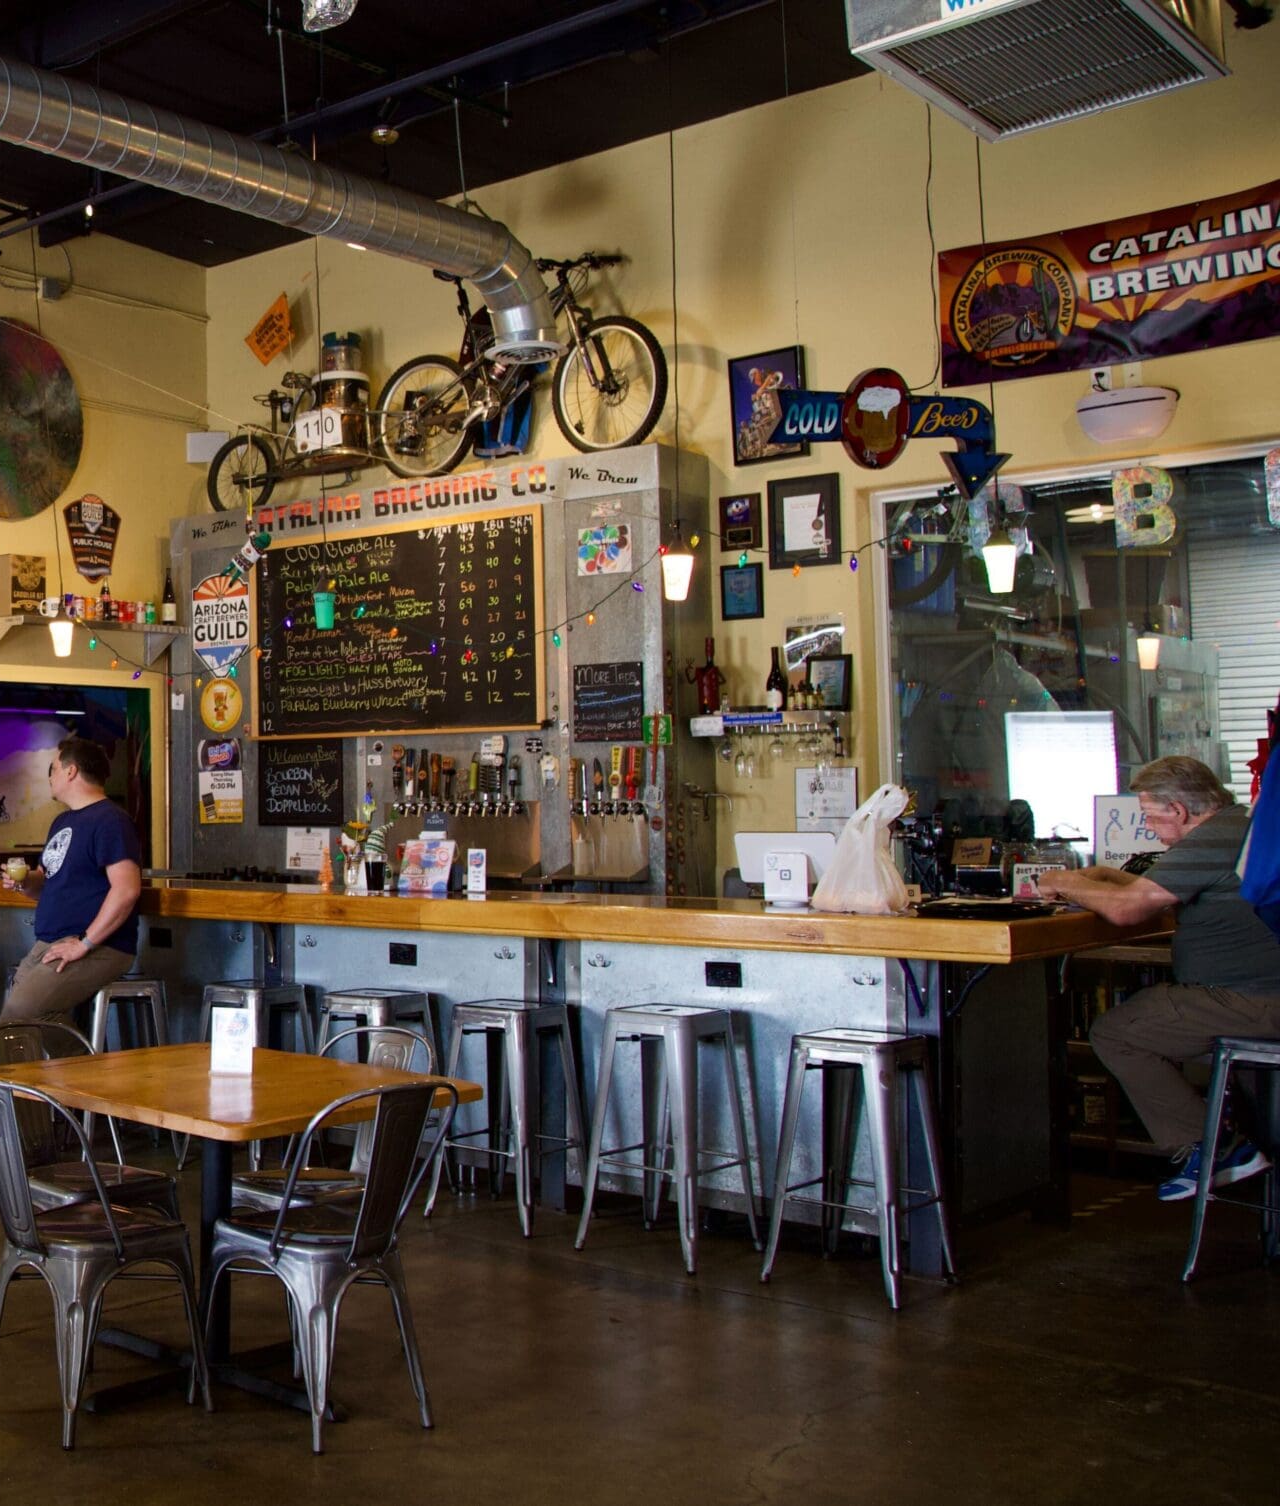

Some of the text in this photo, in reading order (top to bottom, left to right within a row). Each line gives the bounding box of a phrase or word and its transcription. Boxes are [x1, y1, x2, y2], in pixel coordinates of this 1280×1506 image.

[1087, 203, 1280, 264] CATALIN
[956, 269, 983, 332] CATALINA
[1046, 261, 1072, 328] COMPANY
[302, 416, 335, 439] 110
[785, 402, 978, 435] COLD Beer
[568, 467, 639, 485] We Brew
[373, 472, 498, 517] BREWING
[510, 464, 556, 497] CO.
[510, 515, 533, 529] SRM
[73, 538, 93, 546] PUBLIC
[285, 543, 321, 564] CDO
[339, 575, 367, 588] Pale
[370, 571, 391, 584] Ale
[438, 562, 446, 575] 7
[438, 583, 446, 596] 7
[194, 599, 248, 616] ARIZONA
[216, 612, 248, 623] BREWERS
[194, 621, 248, 643] GUILD
[490, 632, 506, 643] 20
[488, 691, 503, 704] 12
[262, 718, 274, 732] 12
